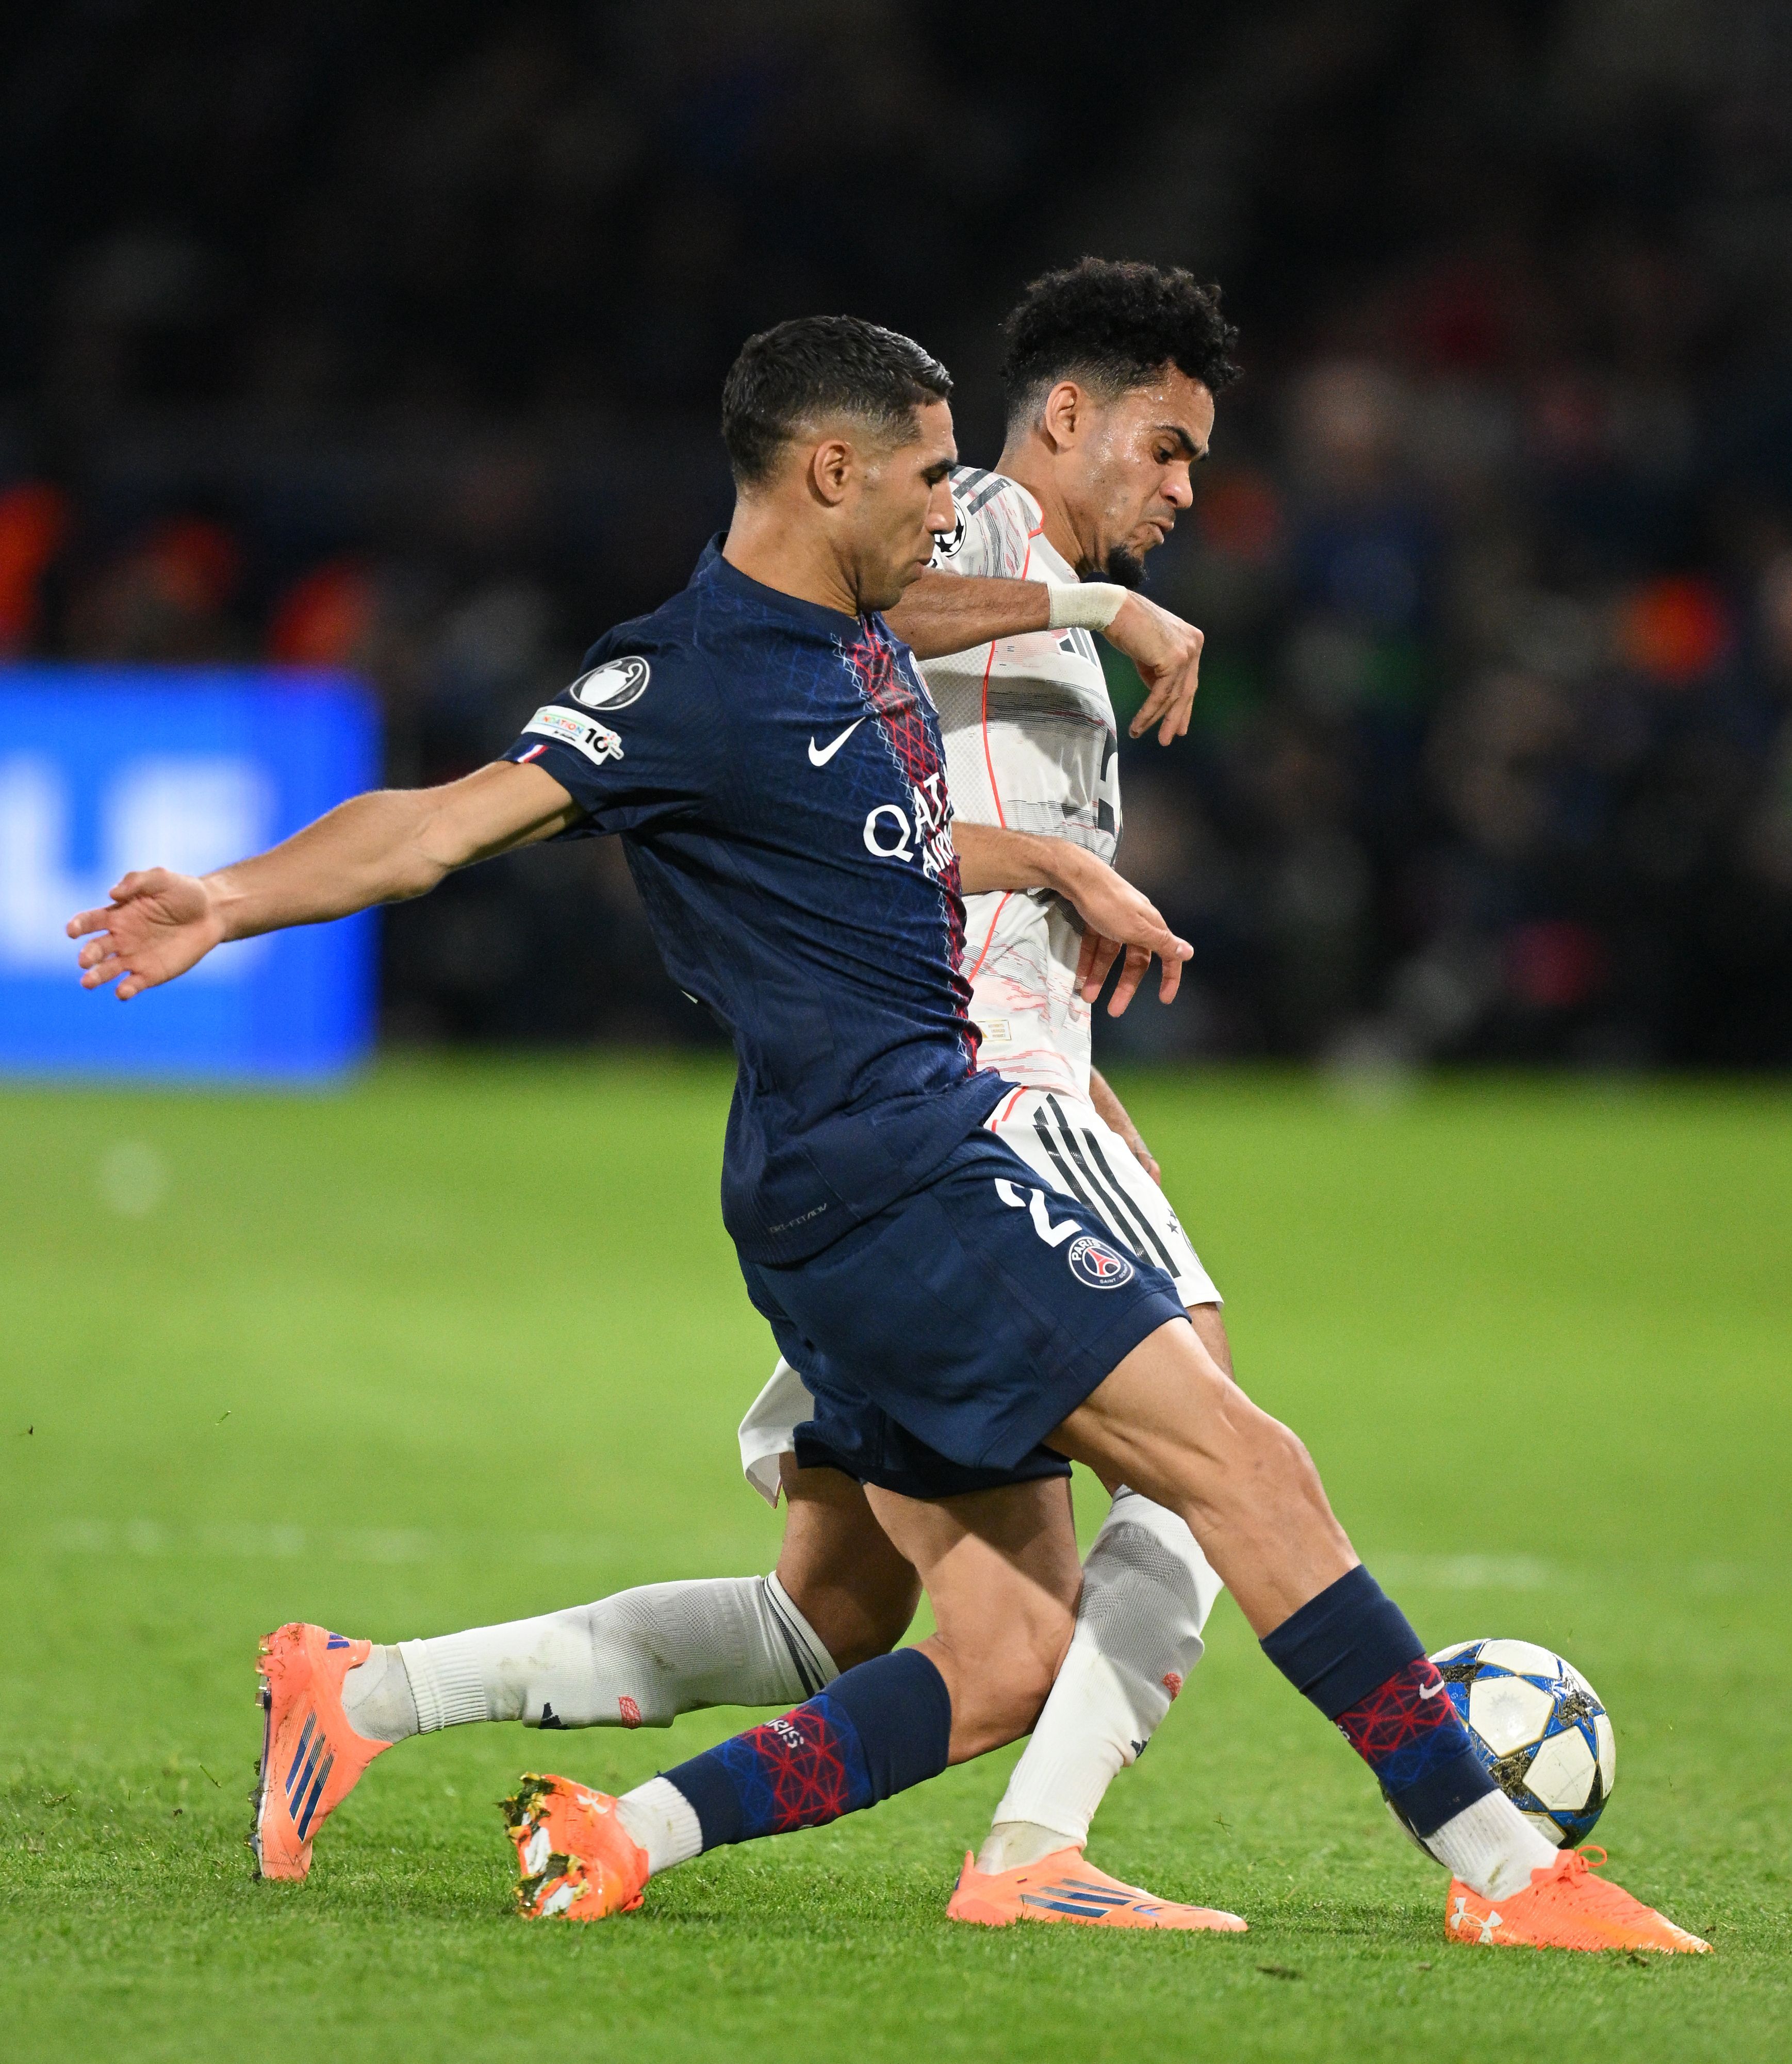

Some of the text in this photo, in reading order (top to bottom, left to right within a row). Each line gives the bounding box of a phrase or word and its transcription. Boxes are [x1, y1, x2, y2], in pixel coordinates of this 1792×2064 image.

[863, 764, 950, 863] QAT
[995, 1178, 1082, 1248] 2
[1072, 1239, 1101, 1261] PARIS
[765, 1720, 804, 1748] RIS
